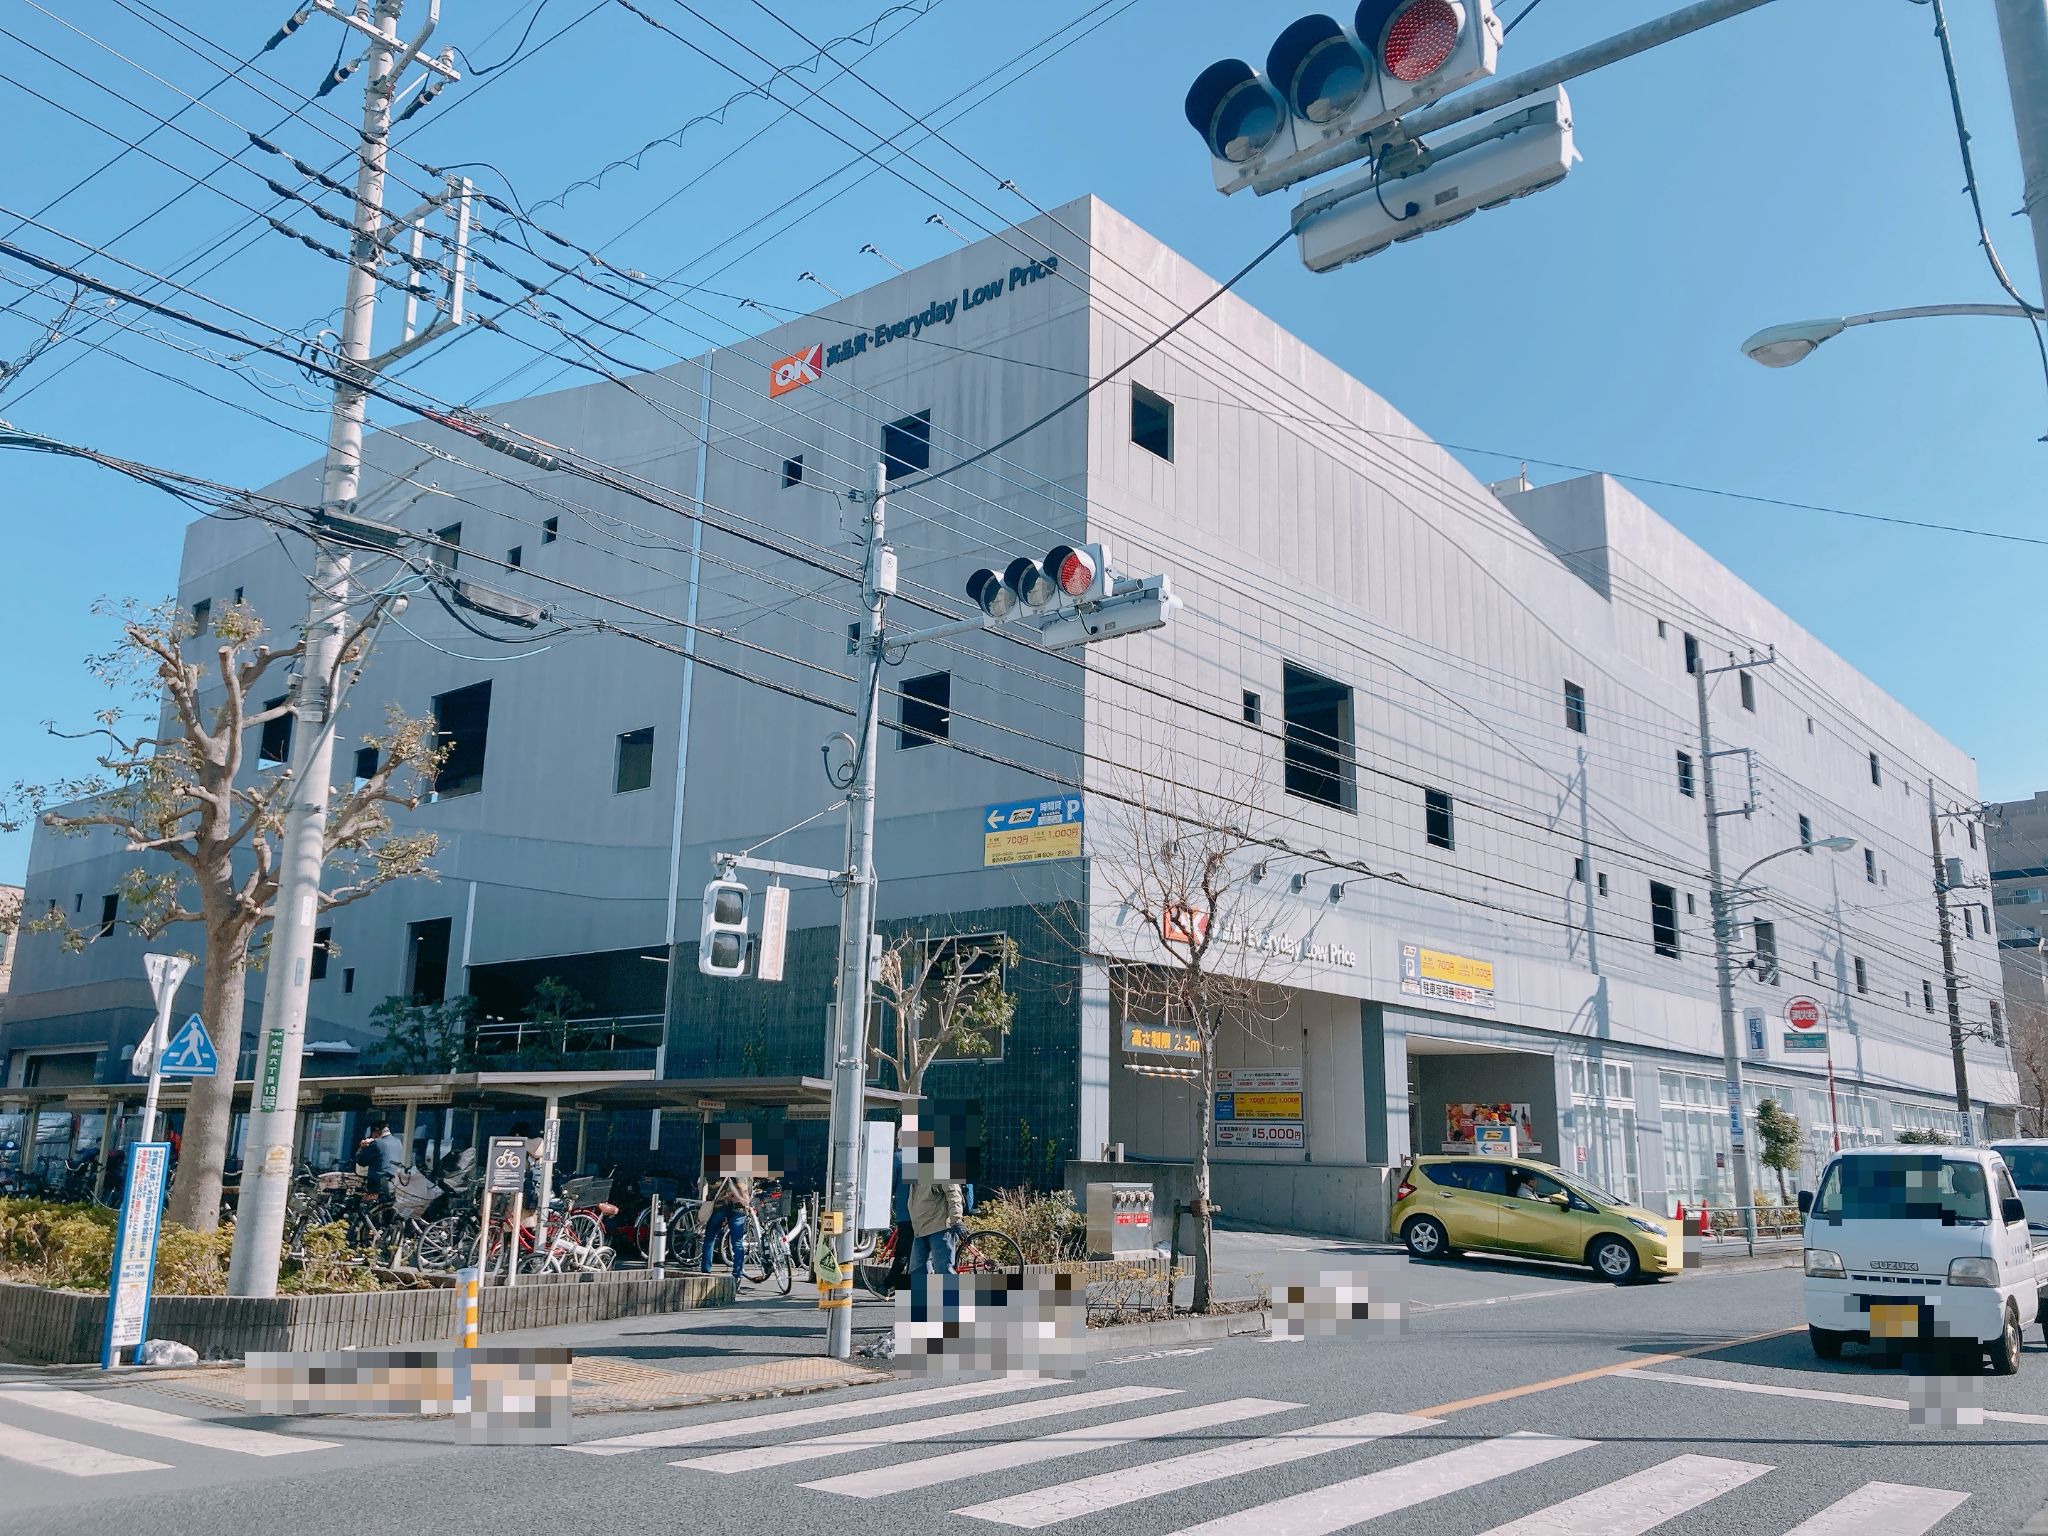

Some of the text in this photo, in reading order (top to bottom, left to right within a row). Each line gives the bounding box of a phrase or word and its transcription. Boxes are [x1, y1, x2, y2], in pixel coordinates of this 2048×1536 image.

[962, 278, 1004, 311] Low
[1009, 256, 1058, 291] Price
[774, 343, 822, 389] OK
[1067, 799, 1080, 820] P
[1304, 938, 1328, 961] Low
[1330, 943, 1356, 968] Price
[1131, 1028, 1200, 1052] 高さ制限 2.3m
[1257, 1128, 1301, 1141] 5,000円
[1870, 1260, 1919, 1271] SUZUKI
